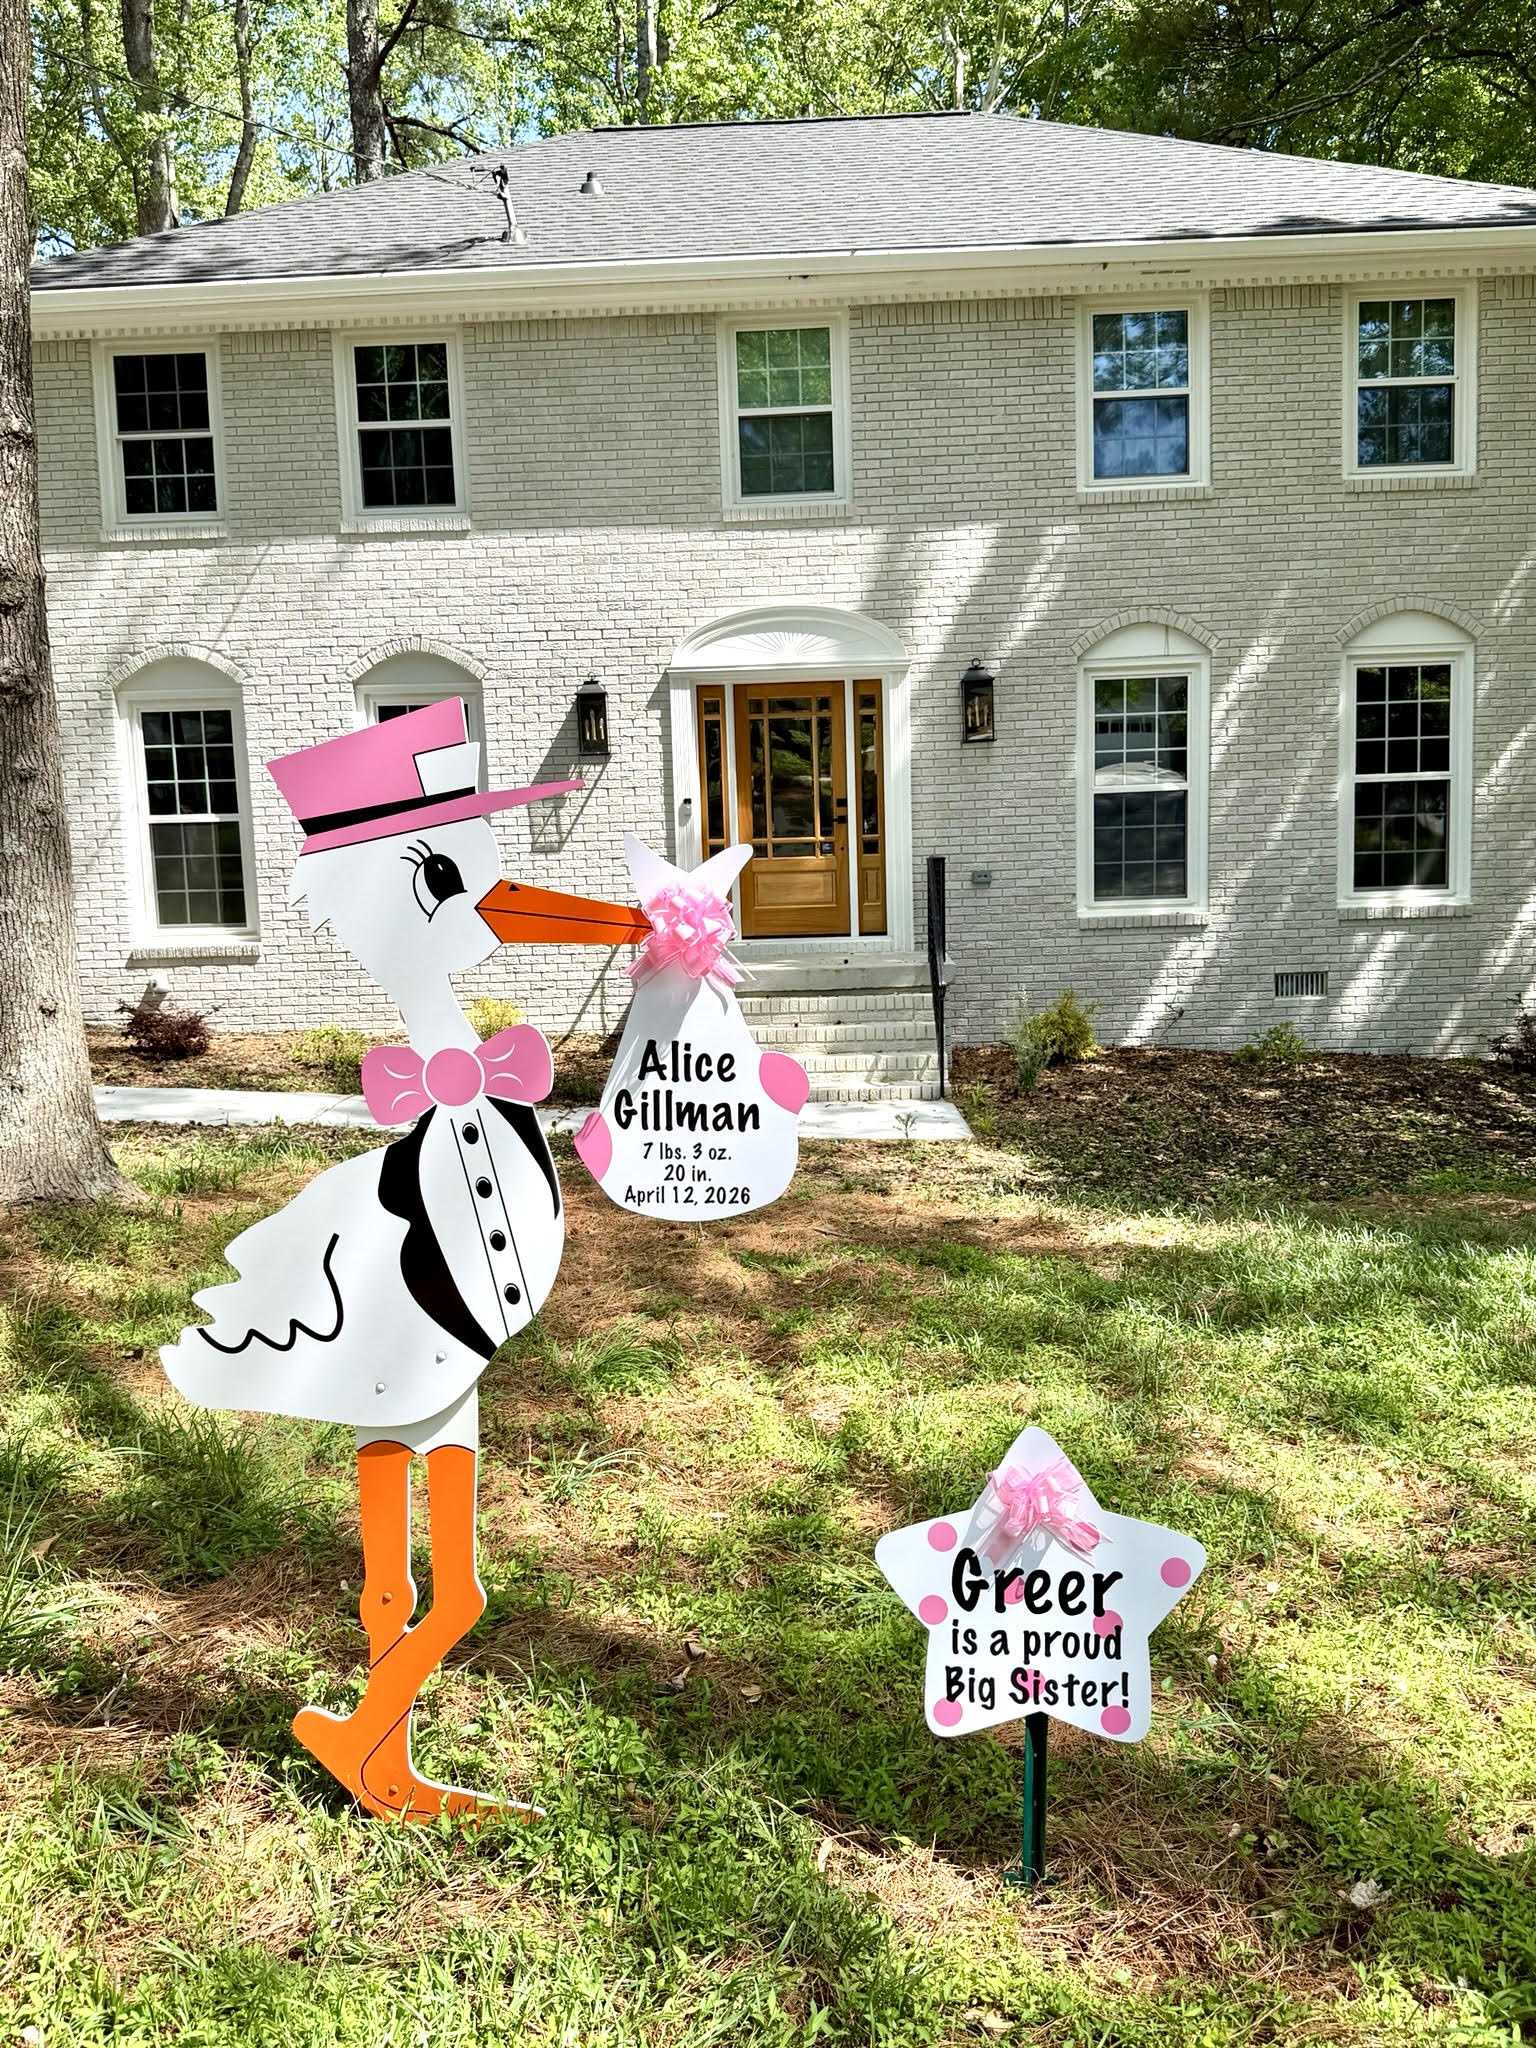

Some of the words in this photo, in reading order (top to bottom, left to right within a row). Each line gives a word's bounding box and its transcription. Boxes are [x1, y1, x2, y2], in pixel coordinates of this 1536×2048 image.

[638, 1039, 736, 1082] Alice
[614, 1089, 760, 1132] Gillman
[643, 1142, 654, 1160] 7
[660, 1142, 686, 1160] lbs.
[693, 1142, 703, 1160] 3
[709, 1147, 732, 1161] oz.
[663, 1164, 685, 1182] 20
[692, 1165, 712, 1182] in.
[624, 1185, 665, 1207] April
[673, 1186, 698, 1206] 12,
[704, 1186, 750, 1205] 2026
[952, 1548, 1123, 1617] Greer
[952, 1619, 977, 1655] is
[990, 1630, 1009, 1656] a
[1024, 1625, 1122, 1664] proud
[945, 1666, 995, 1710] Big
[1008, 1667, 1129, 1709] Sister!
